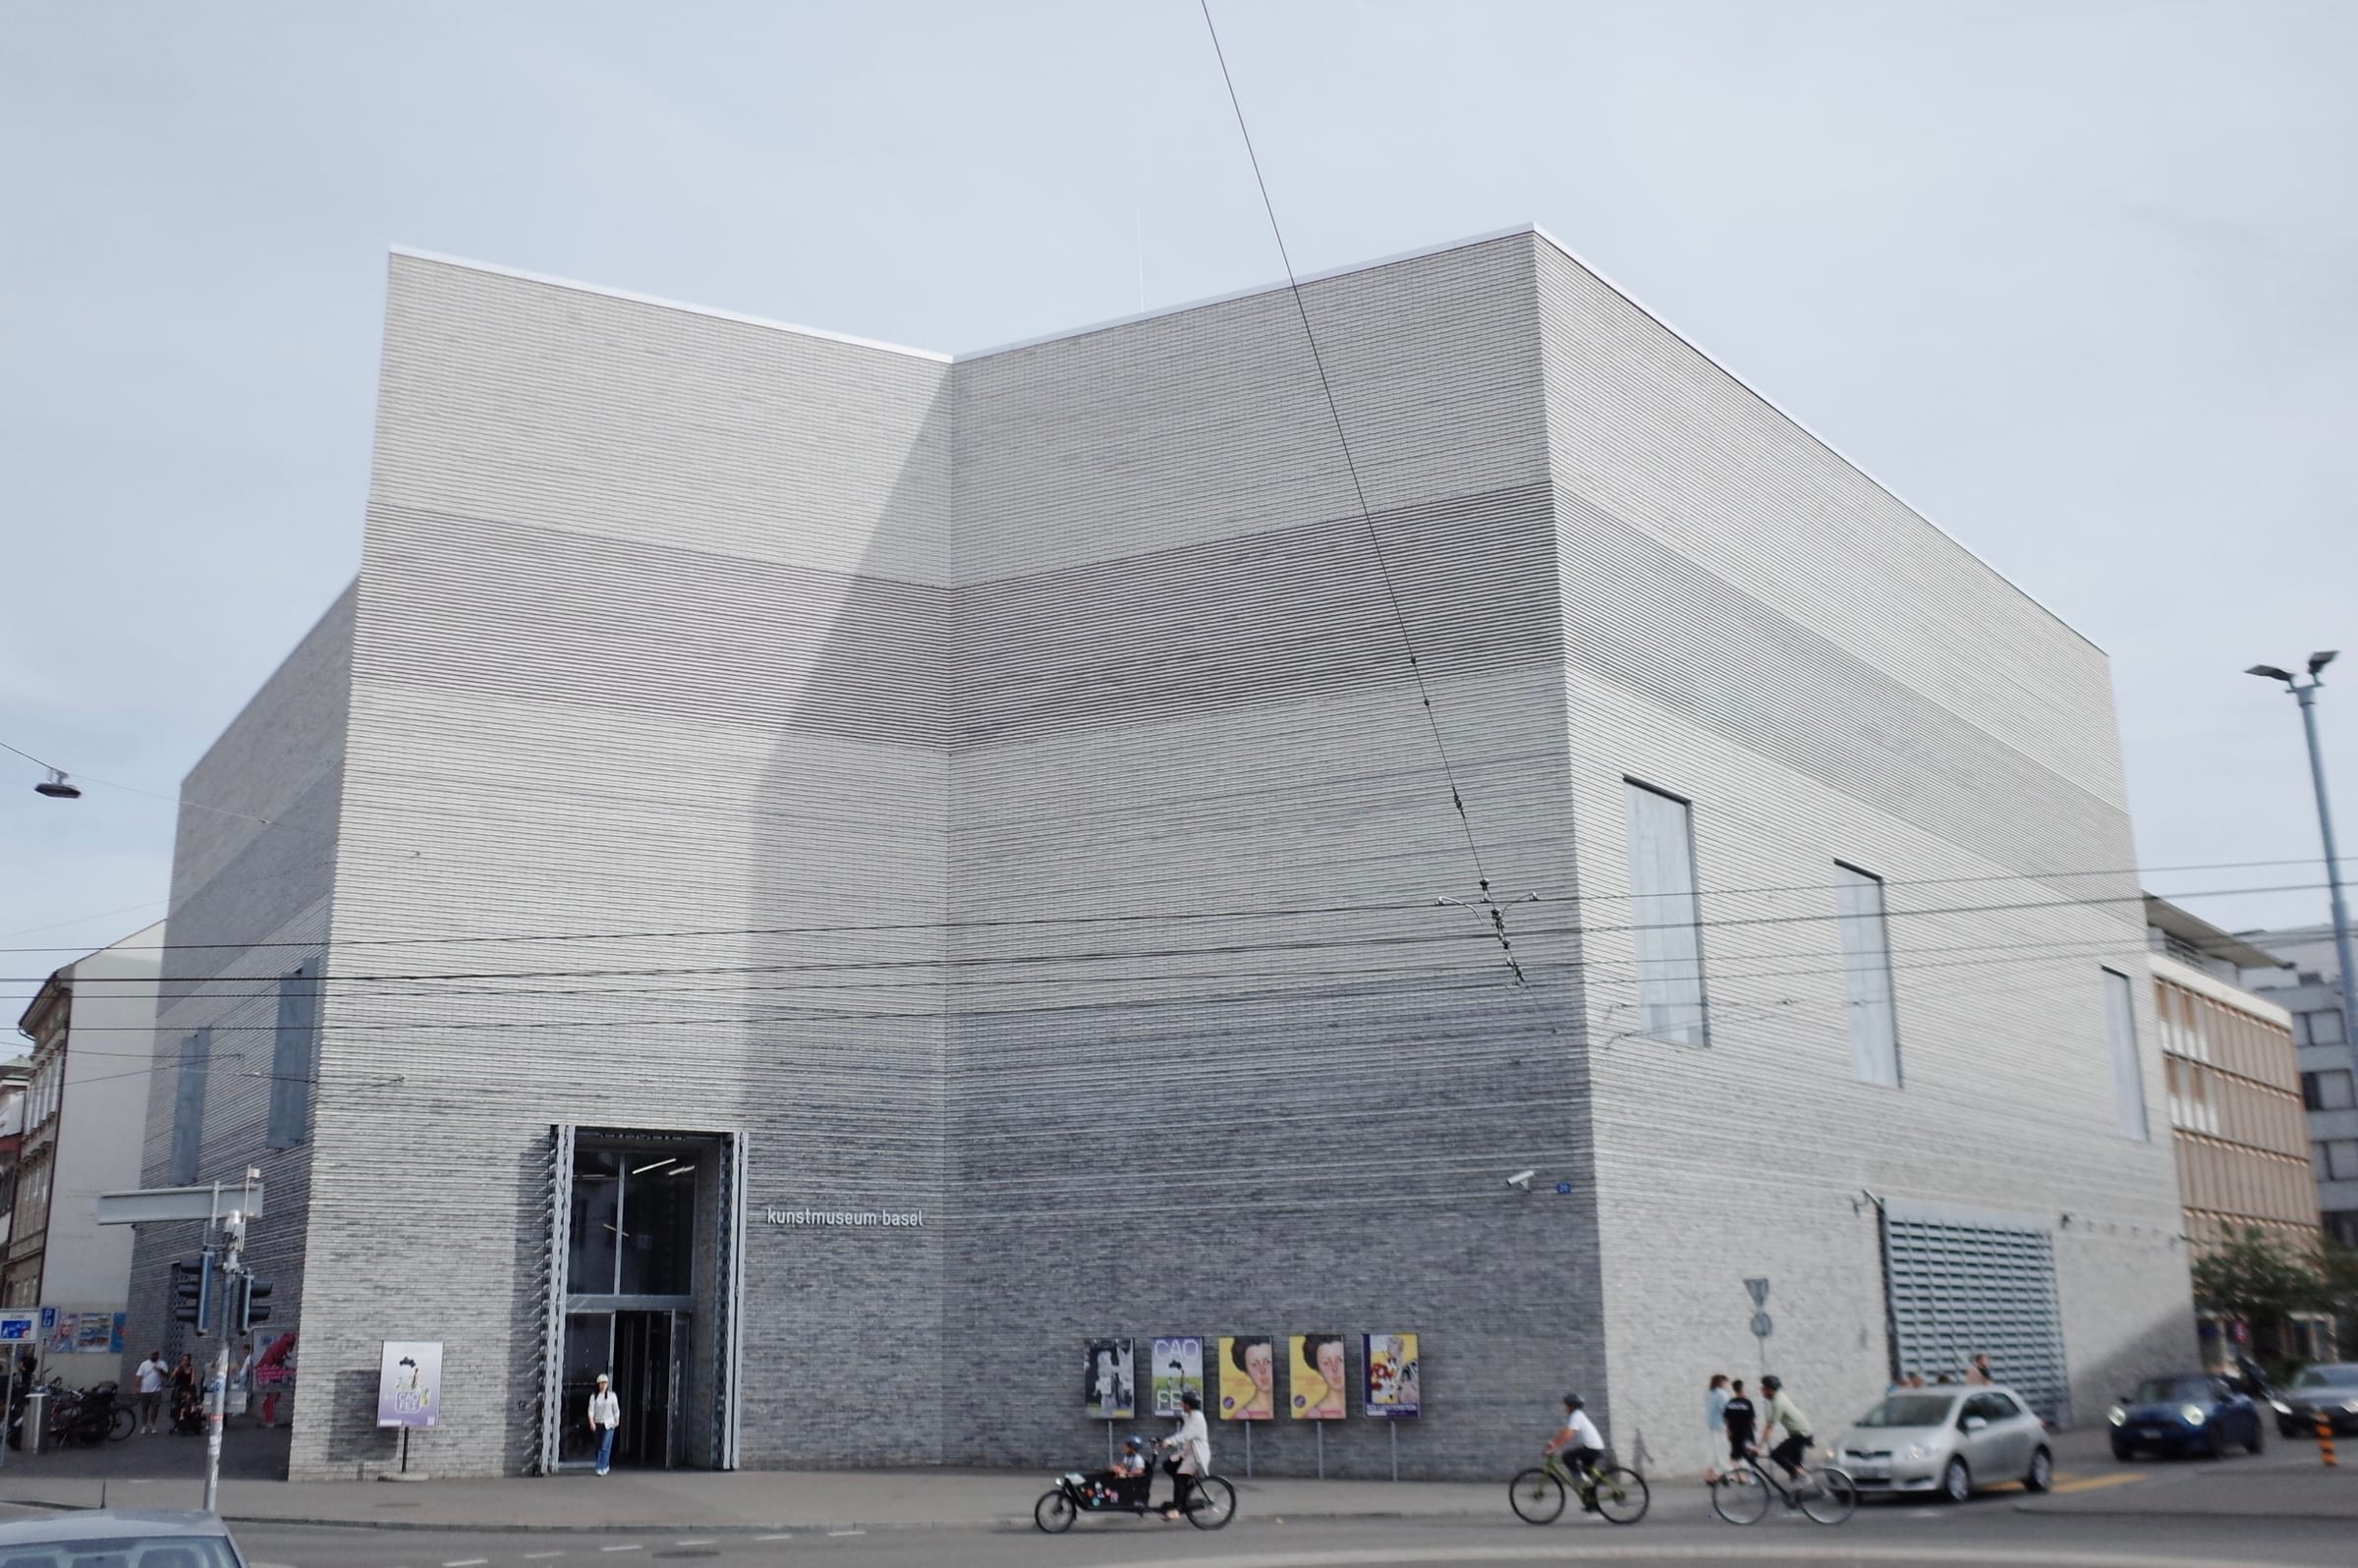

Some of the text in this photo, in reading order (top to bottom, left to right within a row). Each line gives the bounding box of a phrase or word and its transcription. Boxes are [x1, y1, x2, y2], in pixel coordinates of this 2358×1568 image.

[767, 1207, 924, 1226] kunstmuseum basel
[1154, 1339, 1199, 1359] CAO
[1157, 1390, 1183, 1410] FE
